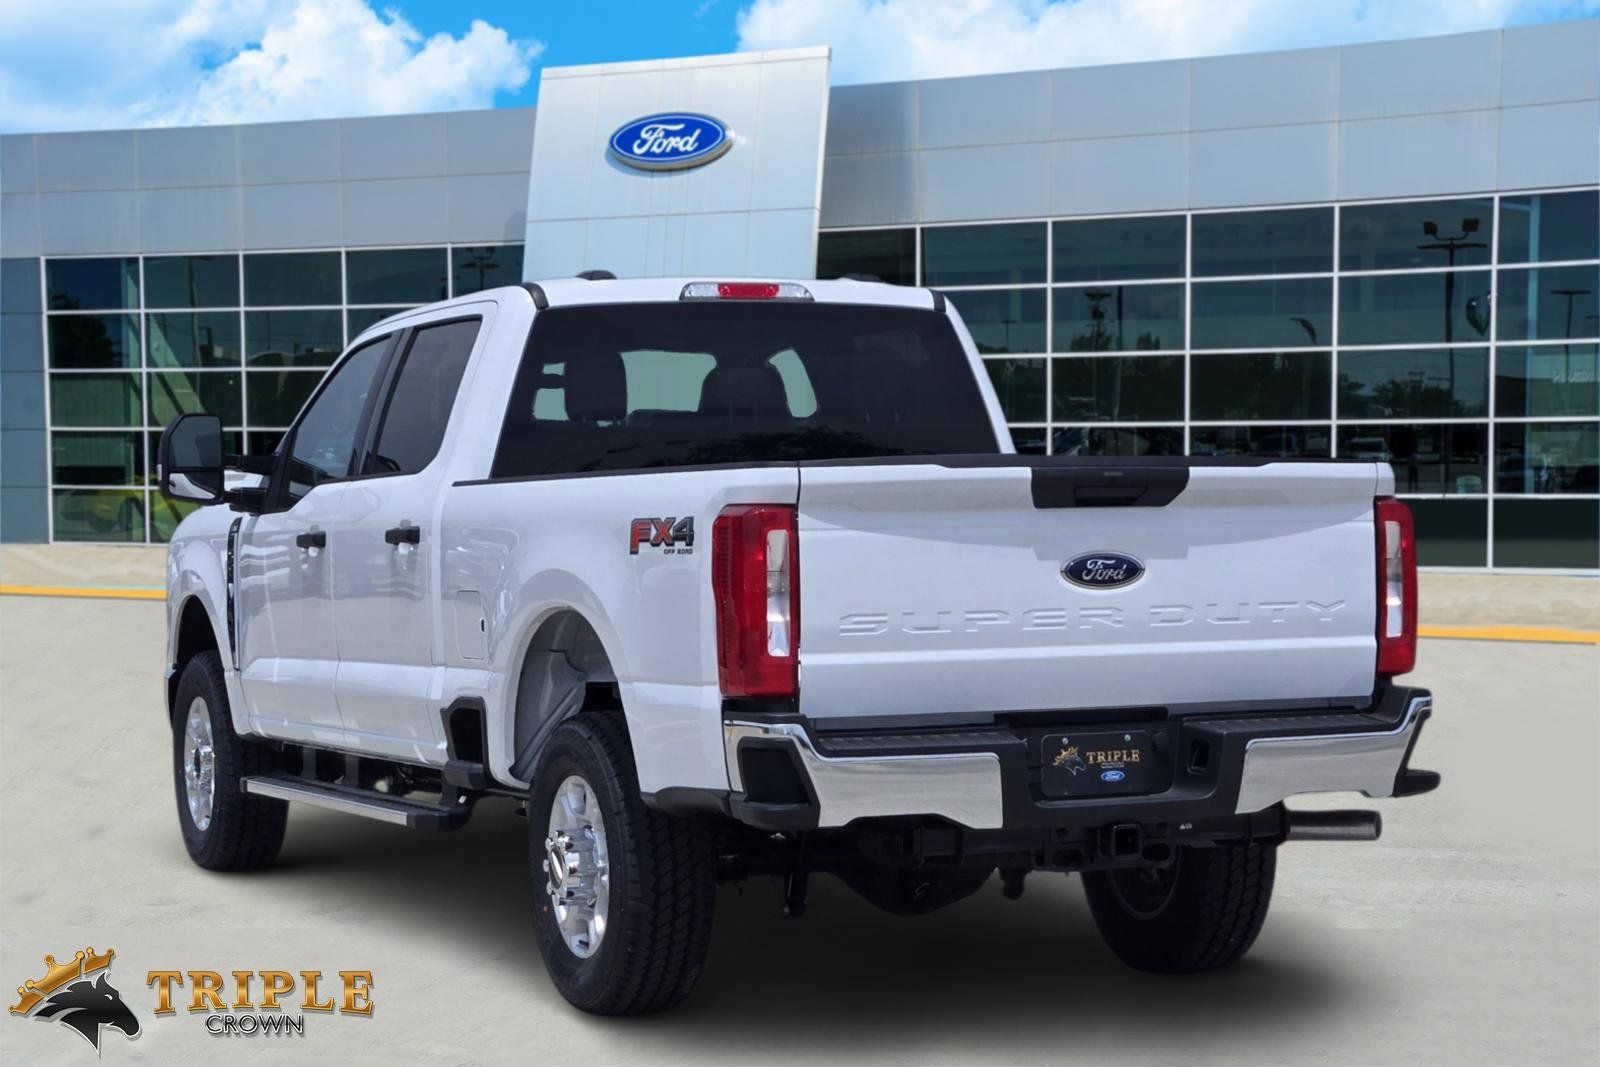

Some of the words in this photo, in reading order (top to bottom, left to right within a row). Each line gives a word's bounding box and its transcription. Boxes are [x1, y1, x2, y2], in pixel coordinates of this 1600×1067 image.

[632, 123, 701, 154] Ford
[629, 516, 694, 555] FX4
[1082, 559, 1127, 580] Ford
[839, 606, 1124, 636] SUPER
[1149, 600, 1347, 627] DUTY
[1086, 749, 1140, 764] TRIPLE
